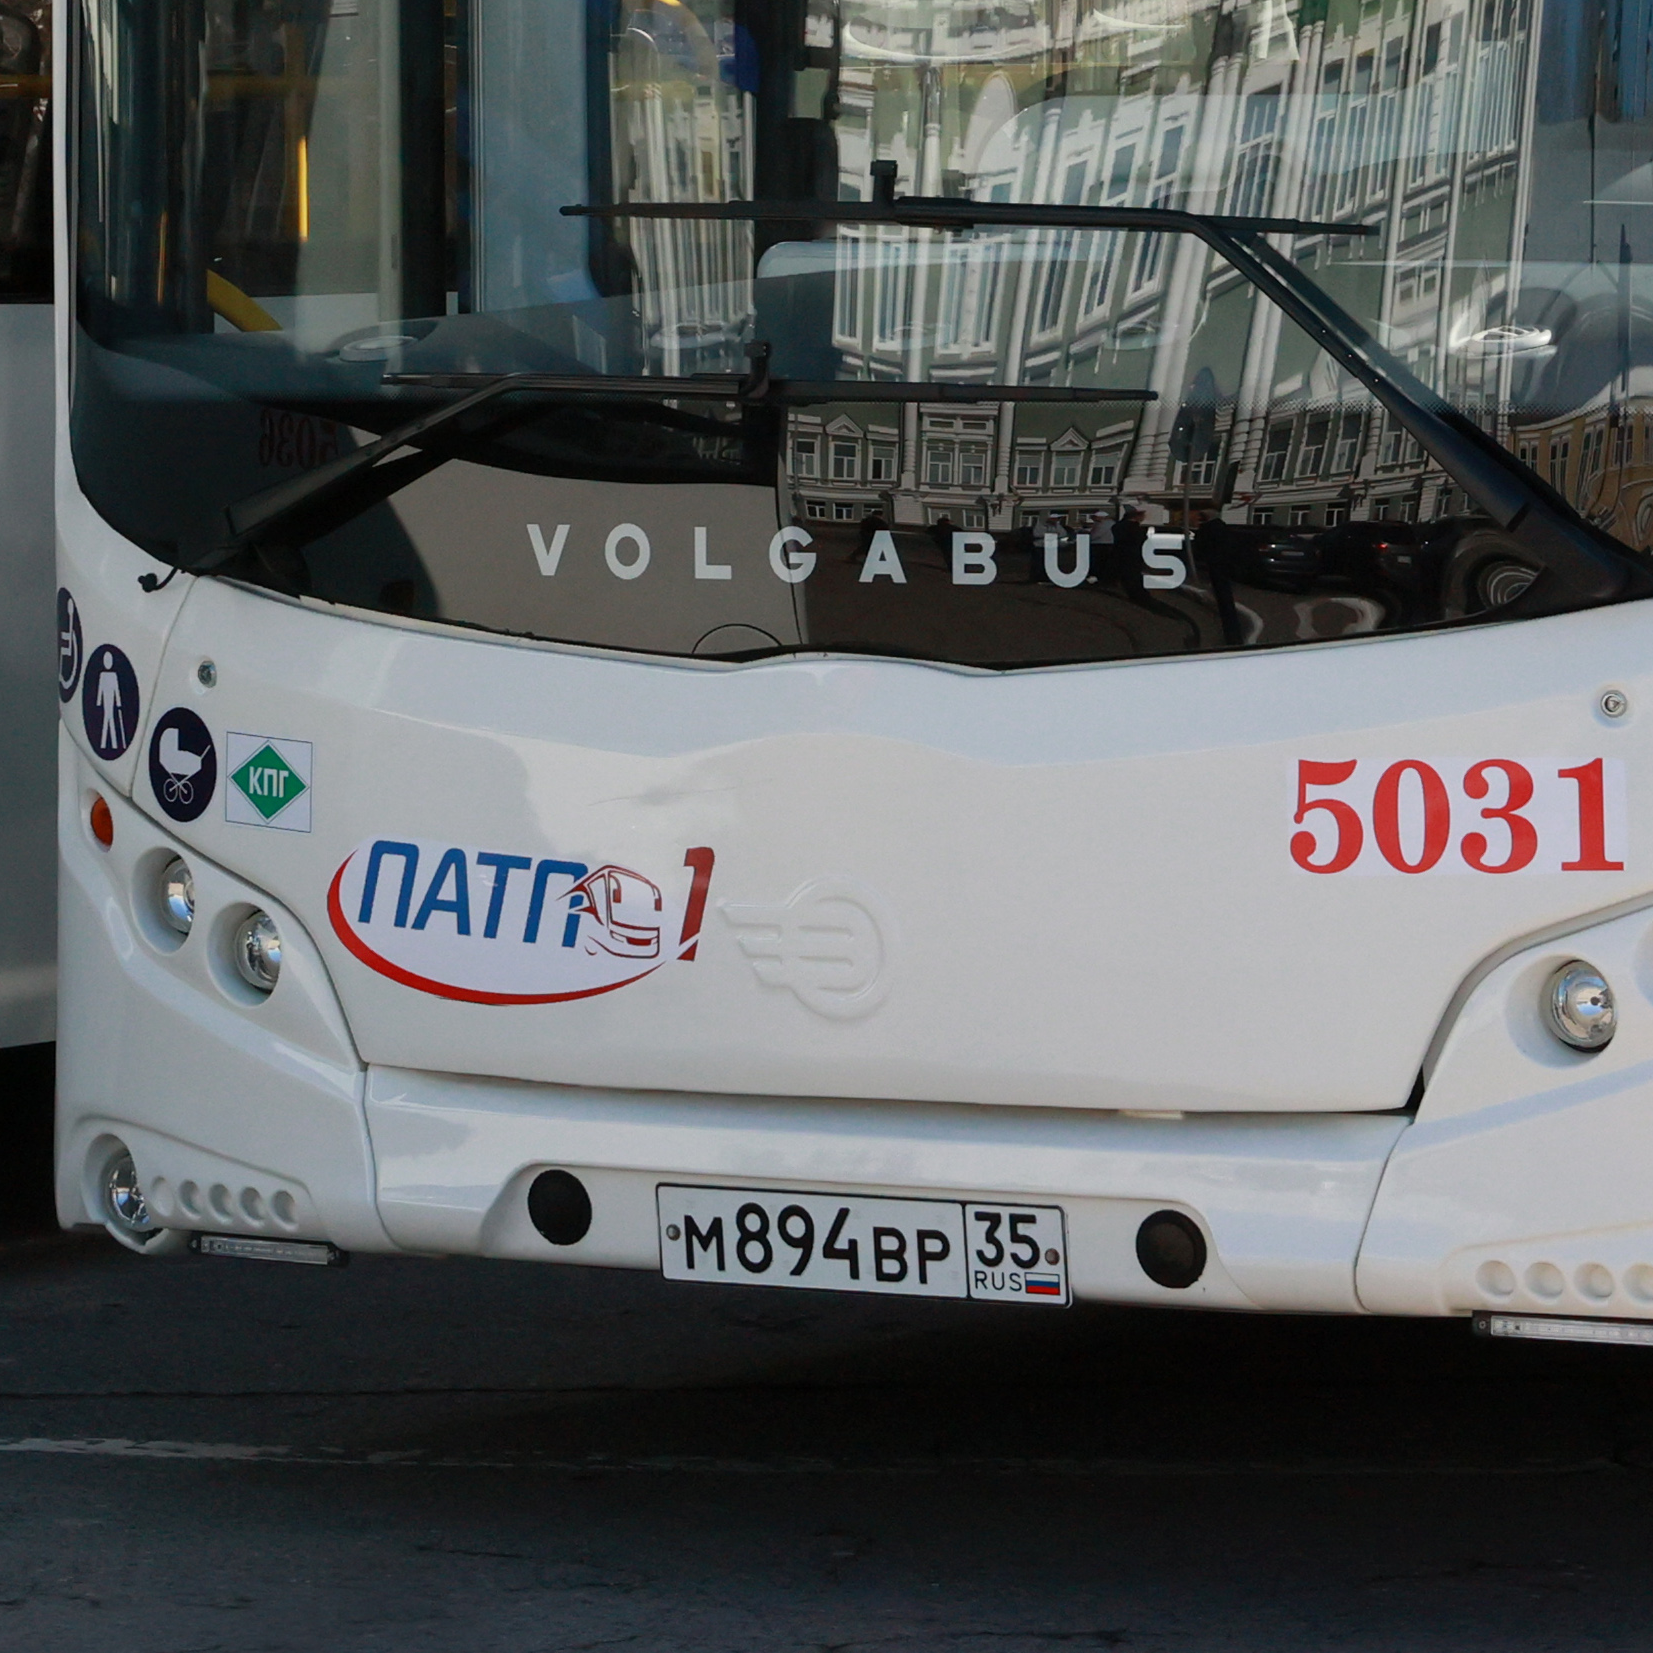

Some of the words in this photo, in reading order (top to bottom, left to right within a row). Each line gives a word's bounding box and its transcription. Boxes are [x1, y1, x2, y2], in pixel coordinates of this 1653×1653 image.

[526, 522, 1187, 589] VOLGABUS
[248, 766, 289, 799] КПГ
[1289, 757, 1625, 875] 5031
[358, 840, 589, 948] ПАТП
[973, 1211, 1041, 1270] 35
[973, 1270, 1023, 1292] RUS
